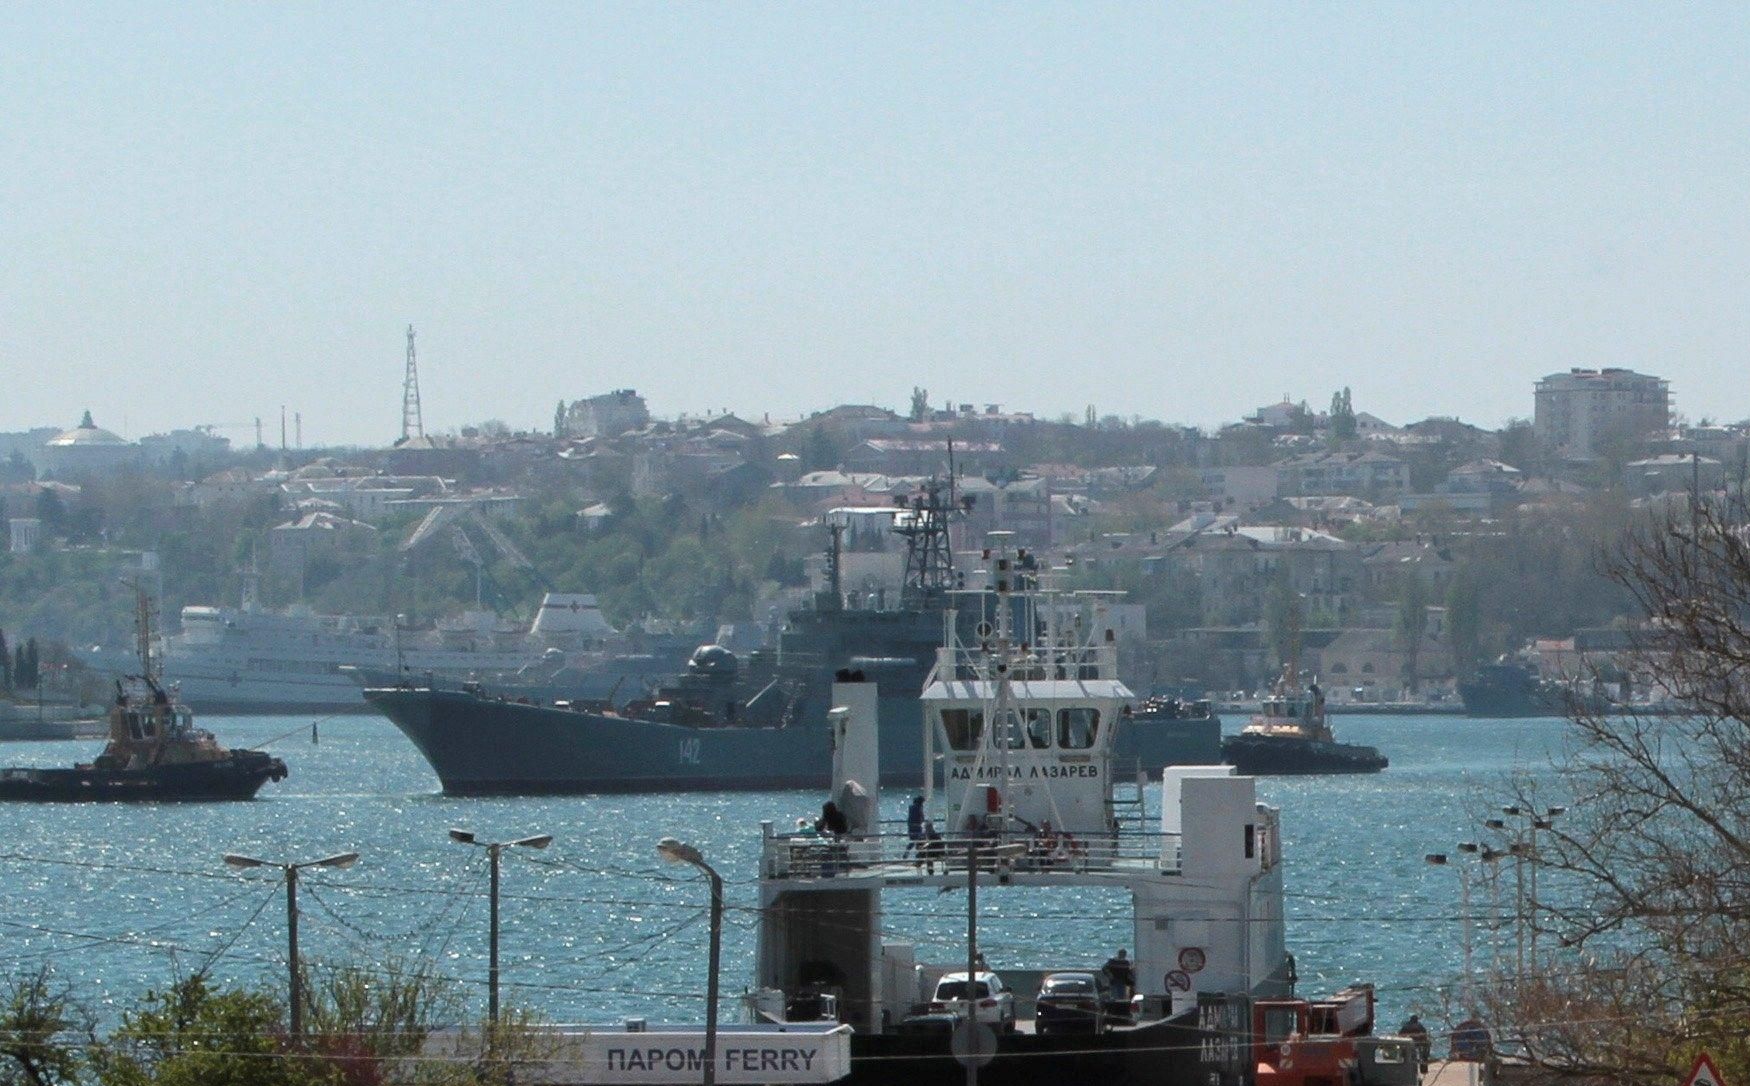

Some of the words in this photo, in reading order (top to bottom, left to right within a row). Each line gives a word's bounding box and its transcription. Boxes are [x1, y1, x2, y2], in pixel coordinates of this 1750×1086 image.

[951, 765, 1022, 780] АДМИРЛ
[1030, 765, 1098, 779] ЛАЗАРЕВ
[607, 1048, 706, 1072] ПАРОМ
[725, 1048, 817, 1072] FERRY
